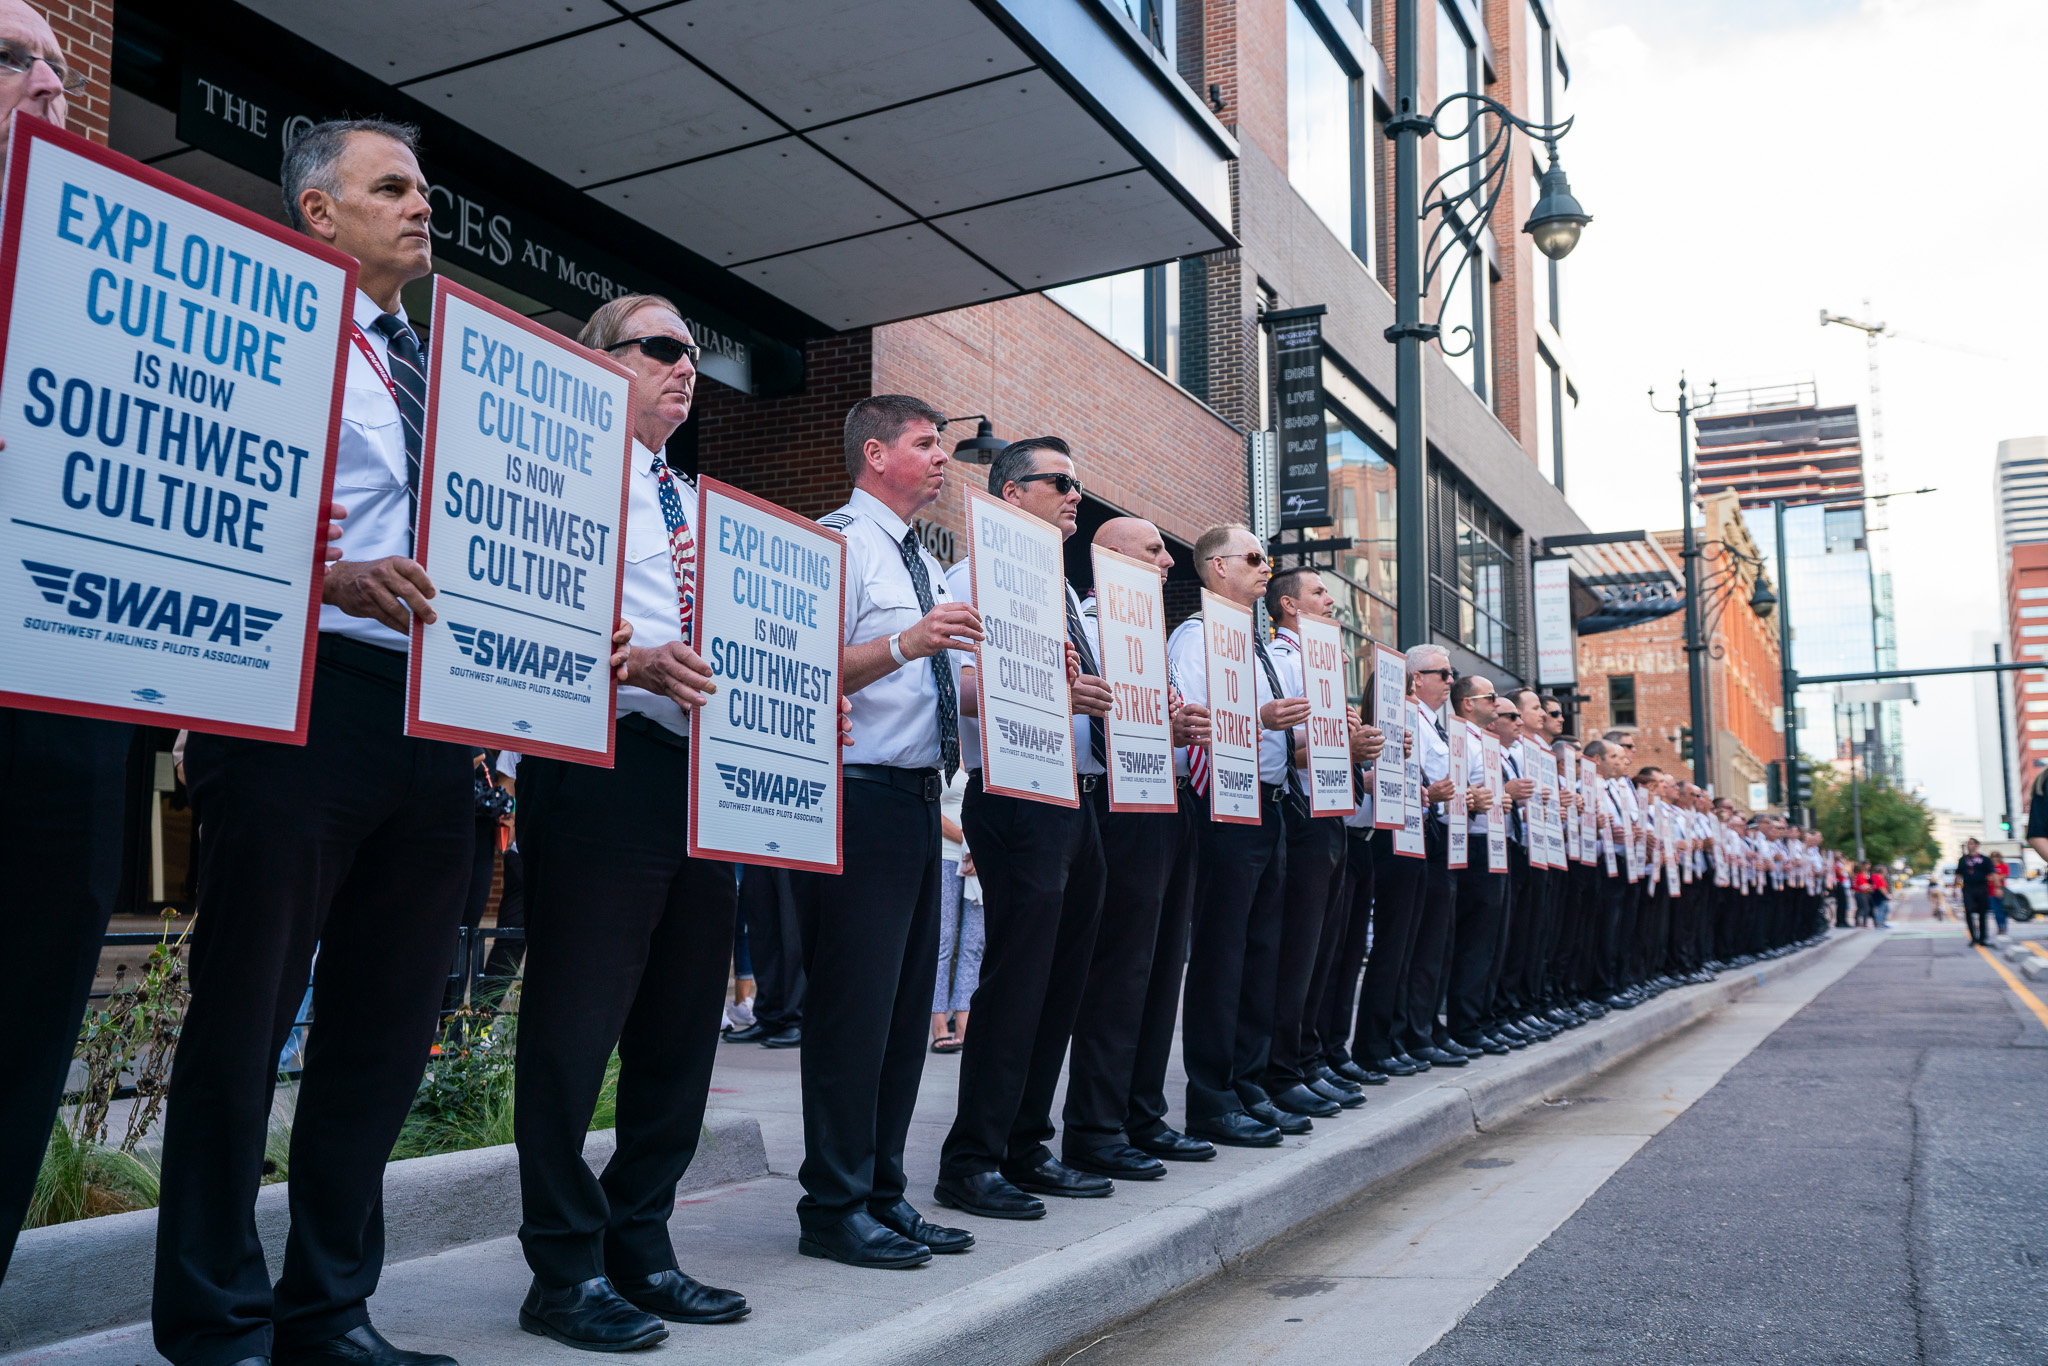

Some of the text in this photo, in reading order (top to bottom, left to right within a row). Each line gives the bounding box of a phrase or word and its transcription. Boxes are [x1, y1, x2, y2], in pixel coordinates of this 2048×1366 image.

[198, 78, 268, 139] THE
[521, 239, 552, 273] AT
[684, 317, 745, 365] QUARE
[57, 181, 318, 333] EXPLOITING
[87, 268, 286, 386] CULTURE
[134, 350, 235, 412] IS NOW
[461, 326, 613, 432] EXPLOITING
[1284, 366, 1315, 381] DINE
[1286, 390, 1316, 405] LIVE
[24, 367, 309, 499] SOUTHWEST
[478, 391, 594, 476] CULTURE
[1284, 414, 1320, 429] SHOP
[1287, 439, 1318, 454] PLAY
[506, 454, 565, 499] IS NOW
[1288, 463, 1319, 478] STAY
[62, 451, 268, 554] CULTURE
[445, 471, 610, 565] SOUTHWEST
[719, 515, 831, 591] EXPLOITING
[916, 518, 957, 563] 1601
[981, 516, 1054, 575] EXPLOITING
[468, 535, 587, 611] CULTURE
[994, 557, 1049, 608] CULTURE
[67, 571, 241, 647] SWAPA
[733, 567, 818, 629] CULTURE
[1010, 598, 1038, 625] IS NOW
[1108, 582, 1153, 630] READY
[23, 617, 270, 670] SOUTHWEST AIRLINES PILOTS ASSOCIATION
[755, 617, 798, 651] IS NOW
[985, 614, 1060, 670] SOUTHWEST
[1125, 634, 1143, 675] TO
[1213, 621, 1246, 664] READY
[1307, 638, 1337, 672] READY
[474, 629, 574, 686] SWAPA
[710, 637, 831, 705] SOUTHWEST
[1000, 656, 1055, 702] CULTURE
[449, 666, 592, 704] SOUTHWEST AIRLINES PILOTS ASSOCIATION
[1114, 681, 1163, 726] STRIKE
[1225, 668, 1238, 703] TO
[1319, 679, 1331, 709] TO
[729, 688, 816, 744] CULTURE
[1009, 720, 1056, 755] SWAPA
[1216, 708, 1252, 749] STRIKE
[1313, 716, 1345, 748] STRIKE
[1126, 751, 1160, 775] SWAPA
[1223, 769, 1249, 792] SWAPA
[1321, 769, 1344, 787] SWAPA
[735, 767, 810, 809] SWAPA
[718, 800, 823, 824] SOUTHWEST AIRLINES PILOTS ASSOCIATION
